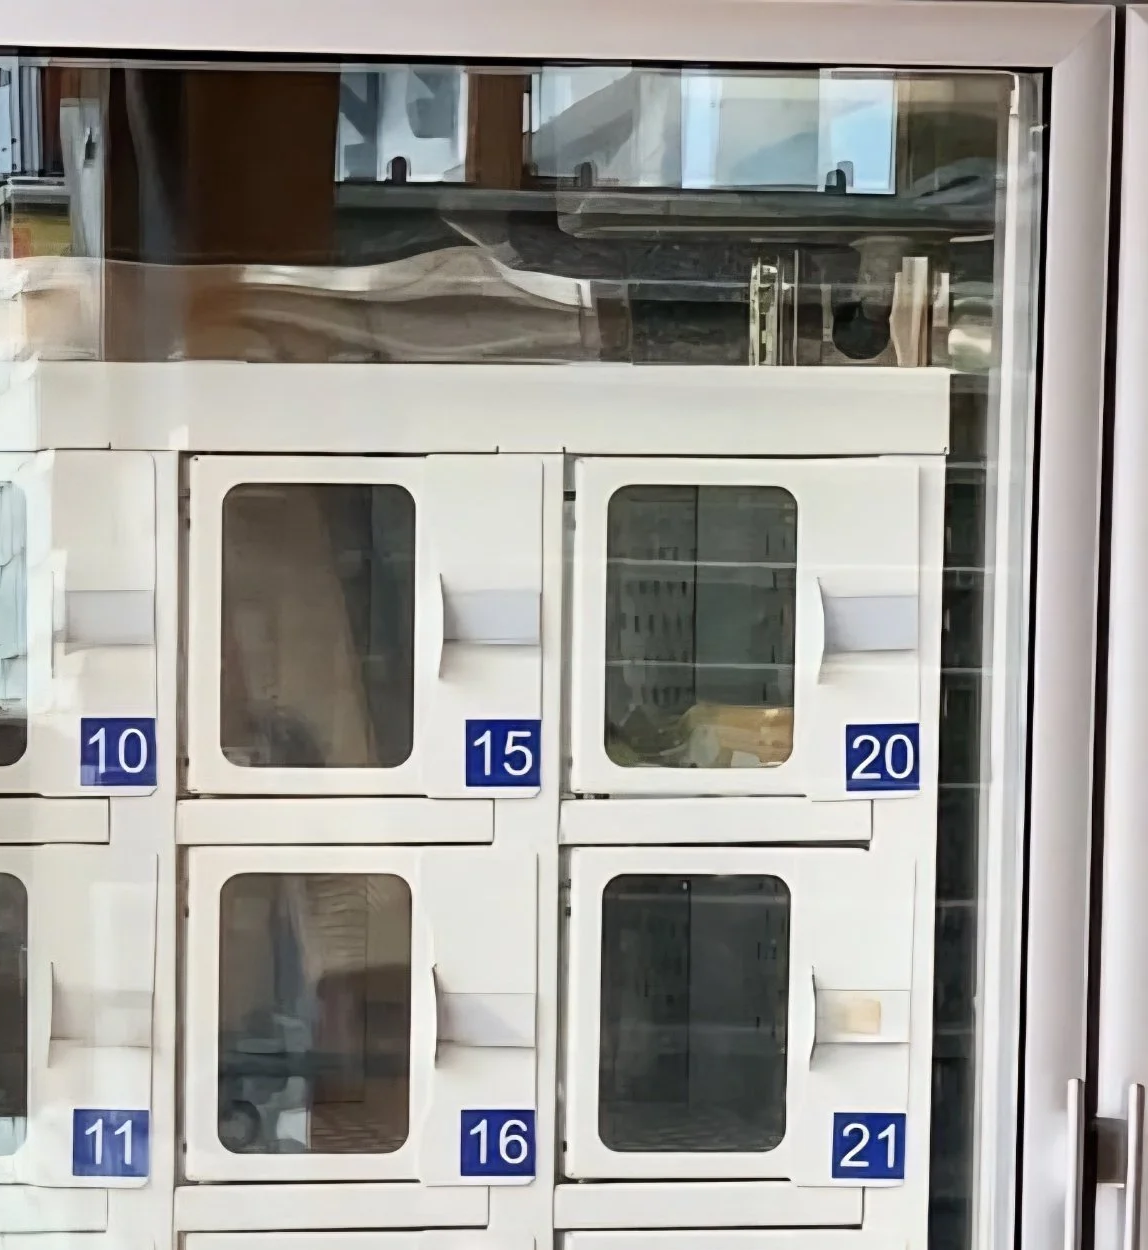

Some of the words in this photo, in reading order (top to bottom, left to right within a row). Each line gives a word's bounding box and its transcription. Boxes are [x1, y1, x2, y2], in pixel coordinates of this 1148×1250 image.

[87, 727, 148, 774] 10
[473, 730, 533, 776] 15
[851, 734, 914, 780] 20
[84, 1118, 133, 1165] 11
[469, 1119, 528, 1164] 16
[840, 1123, 897, 1168] 21
